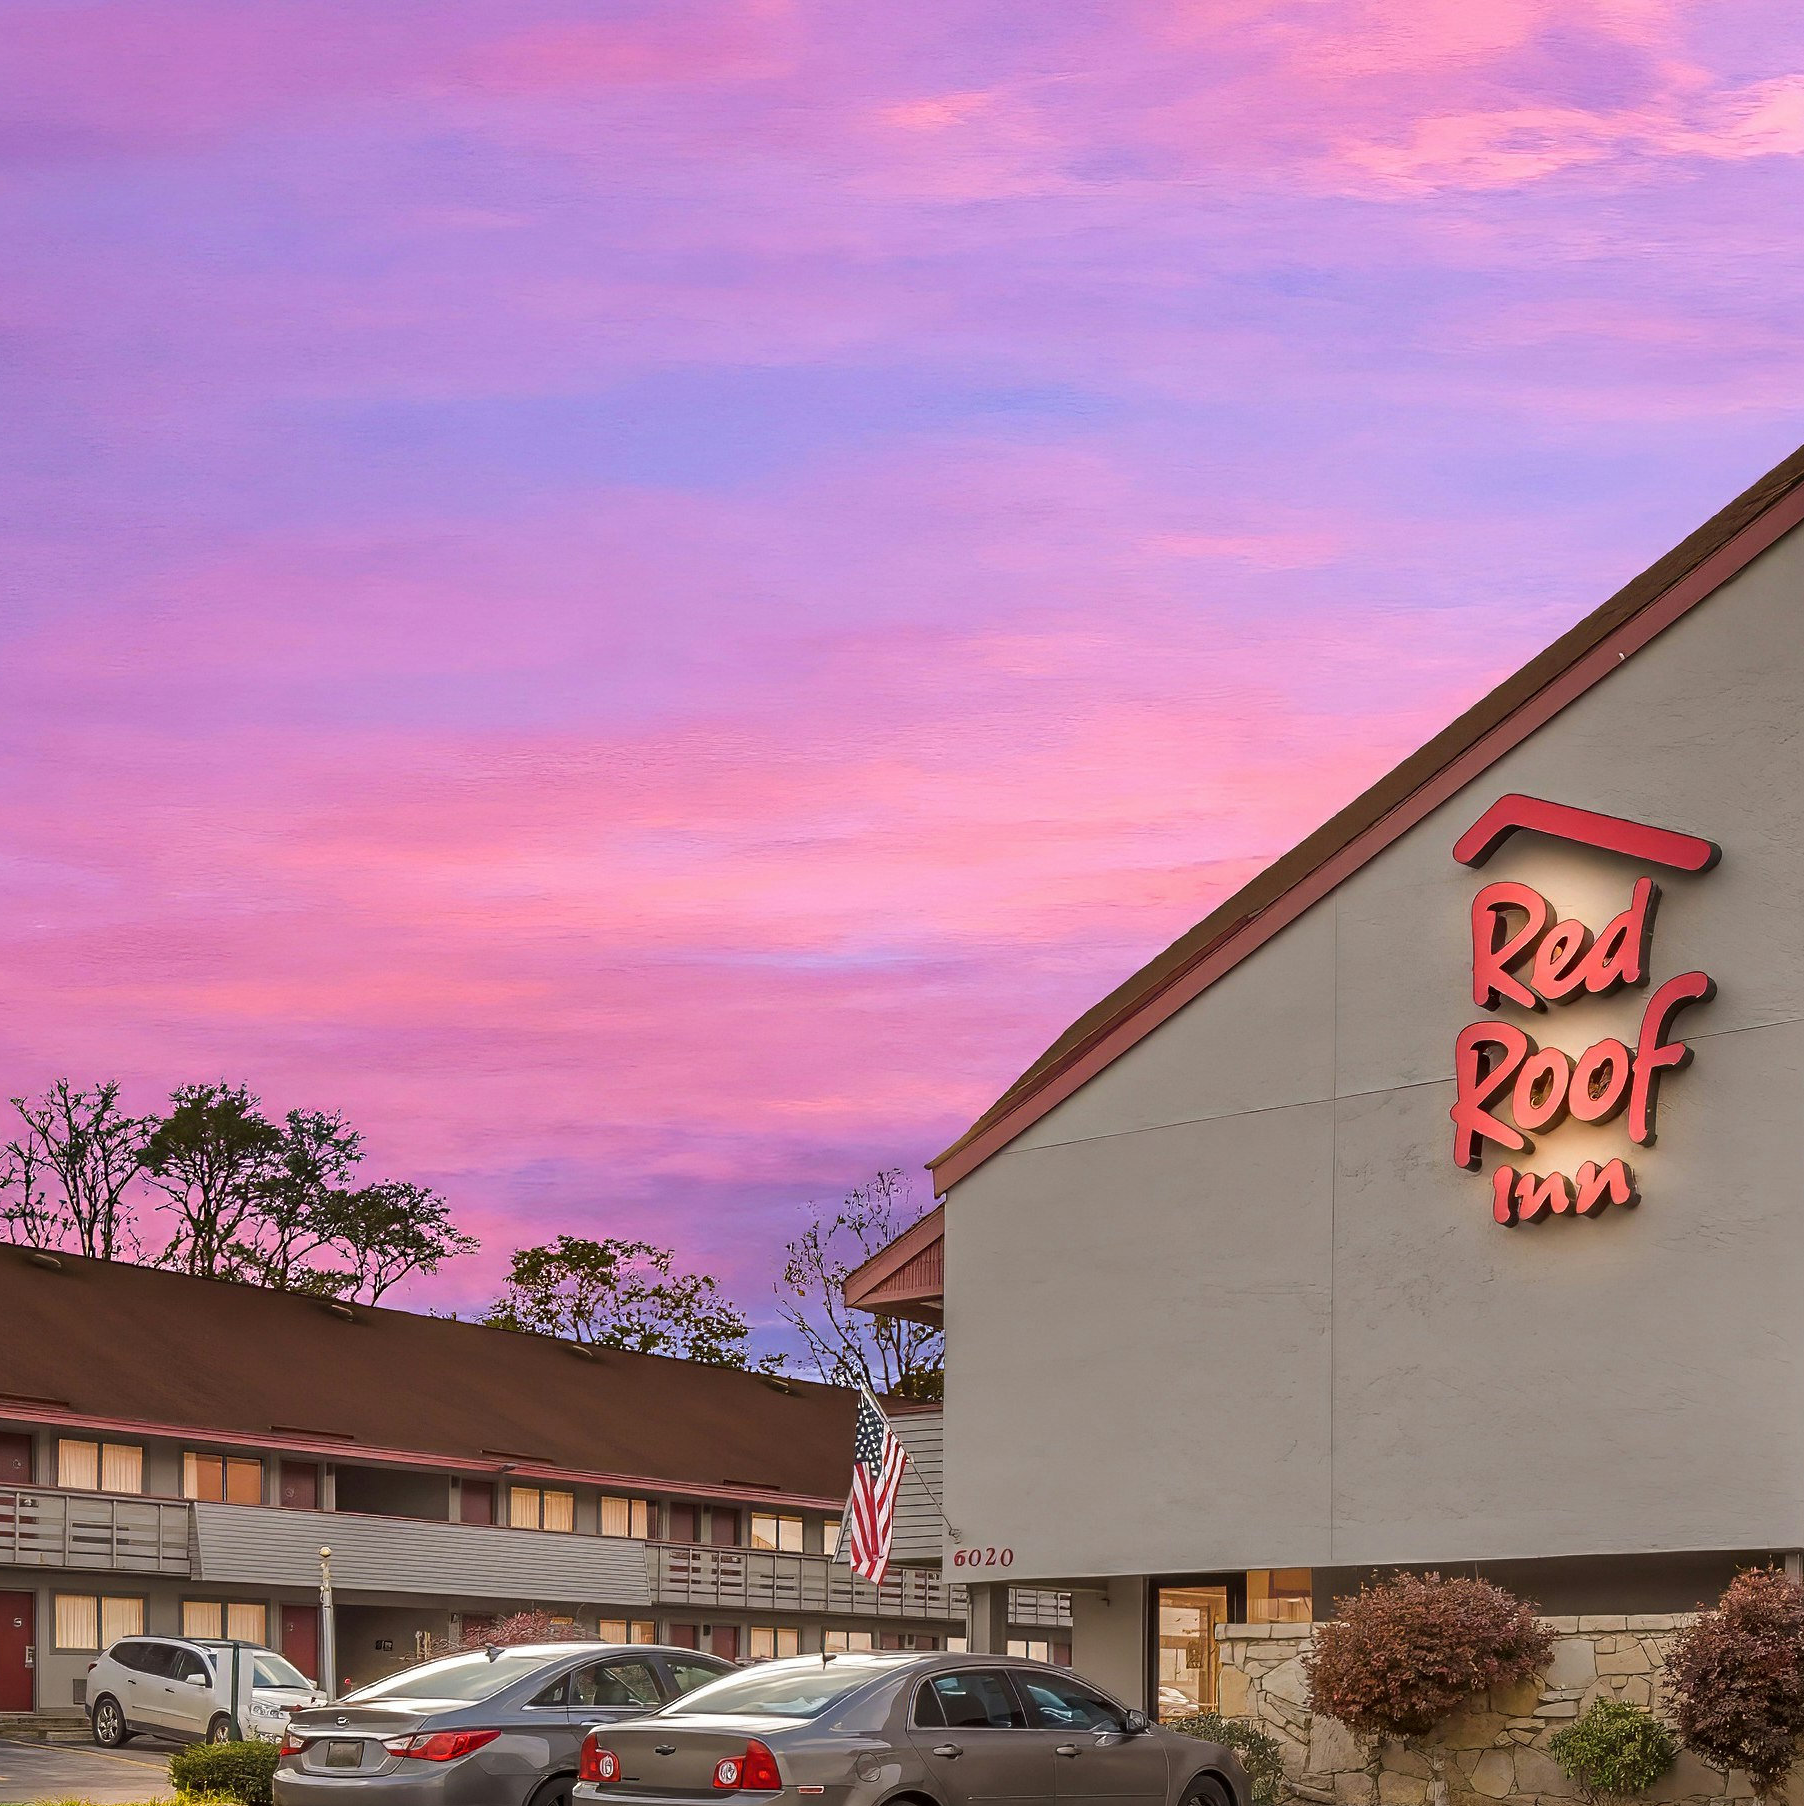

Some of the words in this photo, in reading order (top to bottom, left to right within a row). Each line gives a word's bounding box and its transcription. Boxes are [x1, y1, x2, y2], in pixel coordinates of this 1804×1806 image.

[1471, 876, 1661, 1013] Red
[1450, 971, 1717, 1172] Roof
[954, 1547, 1014, 1567] 6020
